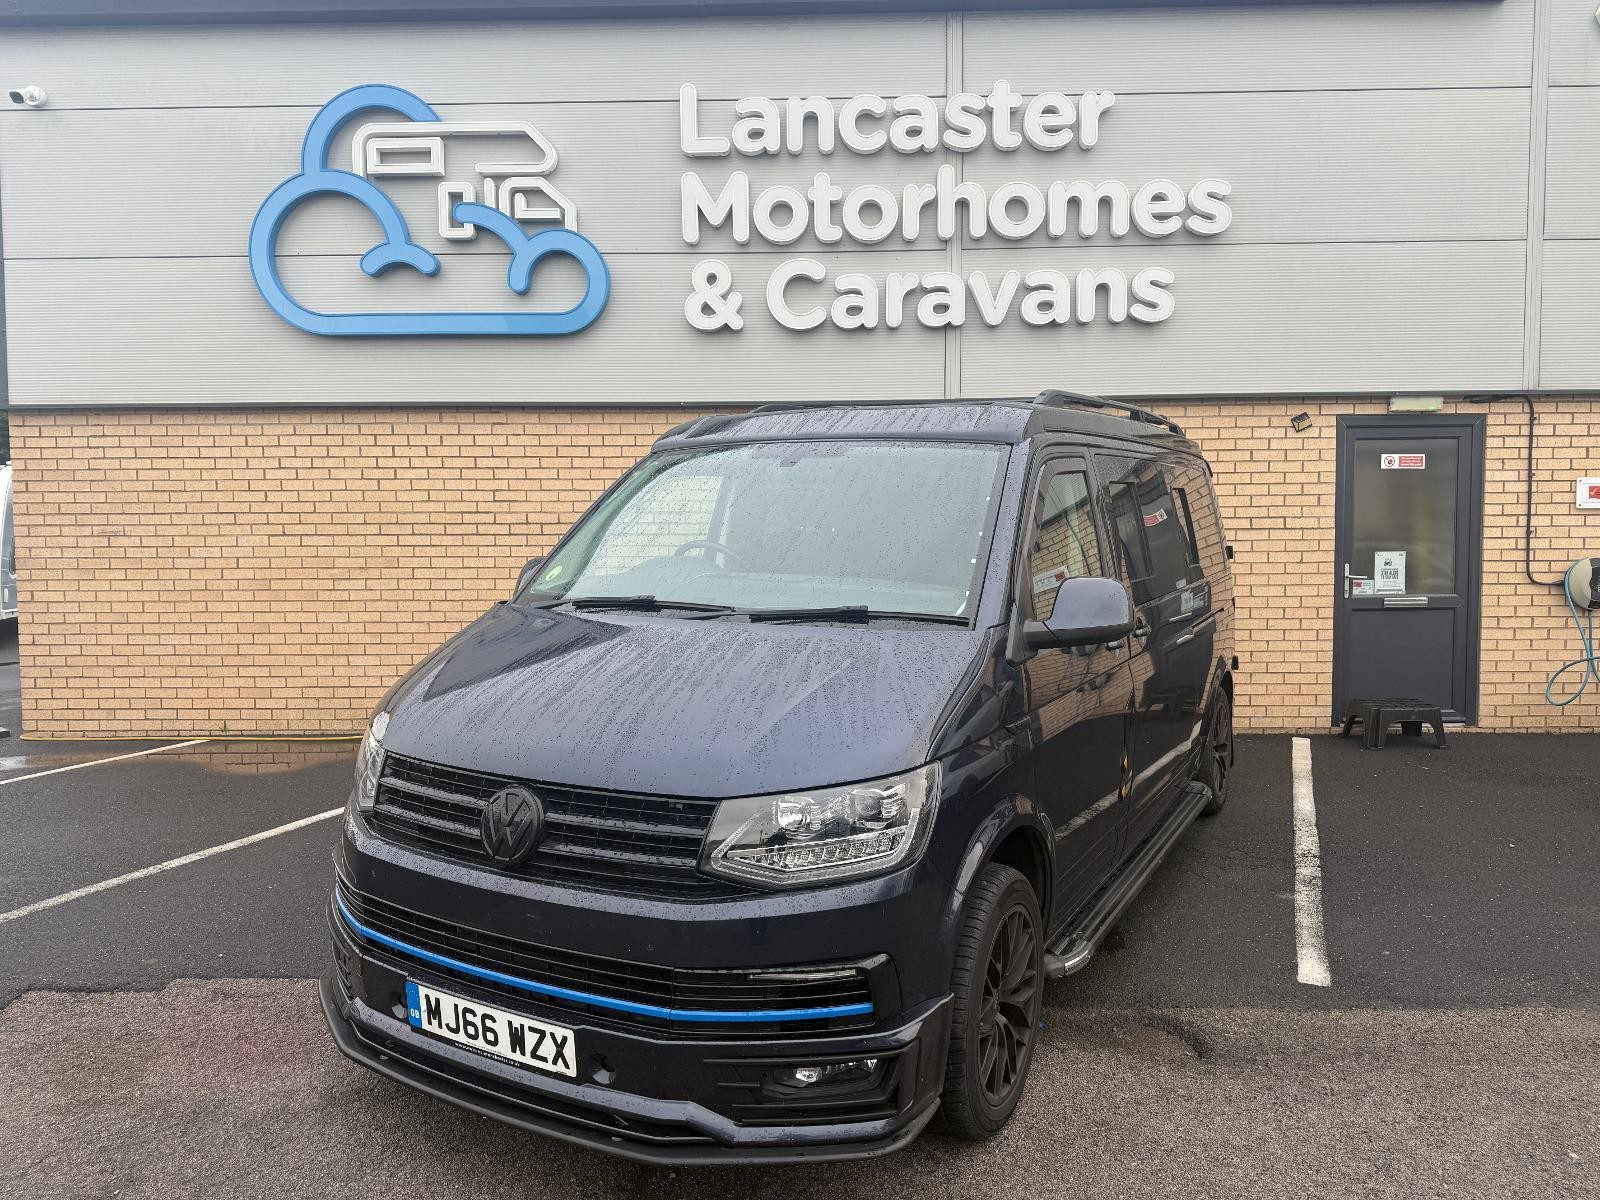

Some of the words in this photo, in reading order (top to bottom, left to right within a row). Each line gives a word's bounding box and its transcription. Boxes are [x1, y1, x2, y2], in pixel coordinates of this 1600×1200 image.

[680, 79, 1115, 157] Lancaster
[681, 164, 1232, 245] Motorhomes
[684, 258, 744, 331] &
[766, 257, 1176, 331] Caravans
[410, 1008, 420, 1019] GB
[424, 993, 499, 1048] MJ66
[507, 1019, 571, 1070] WZX
